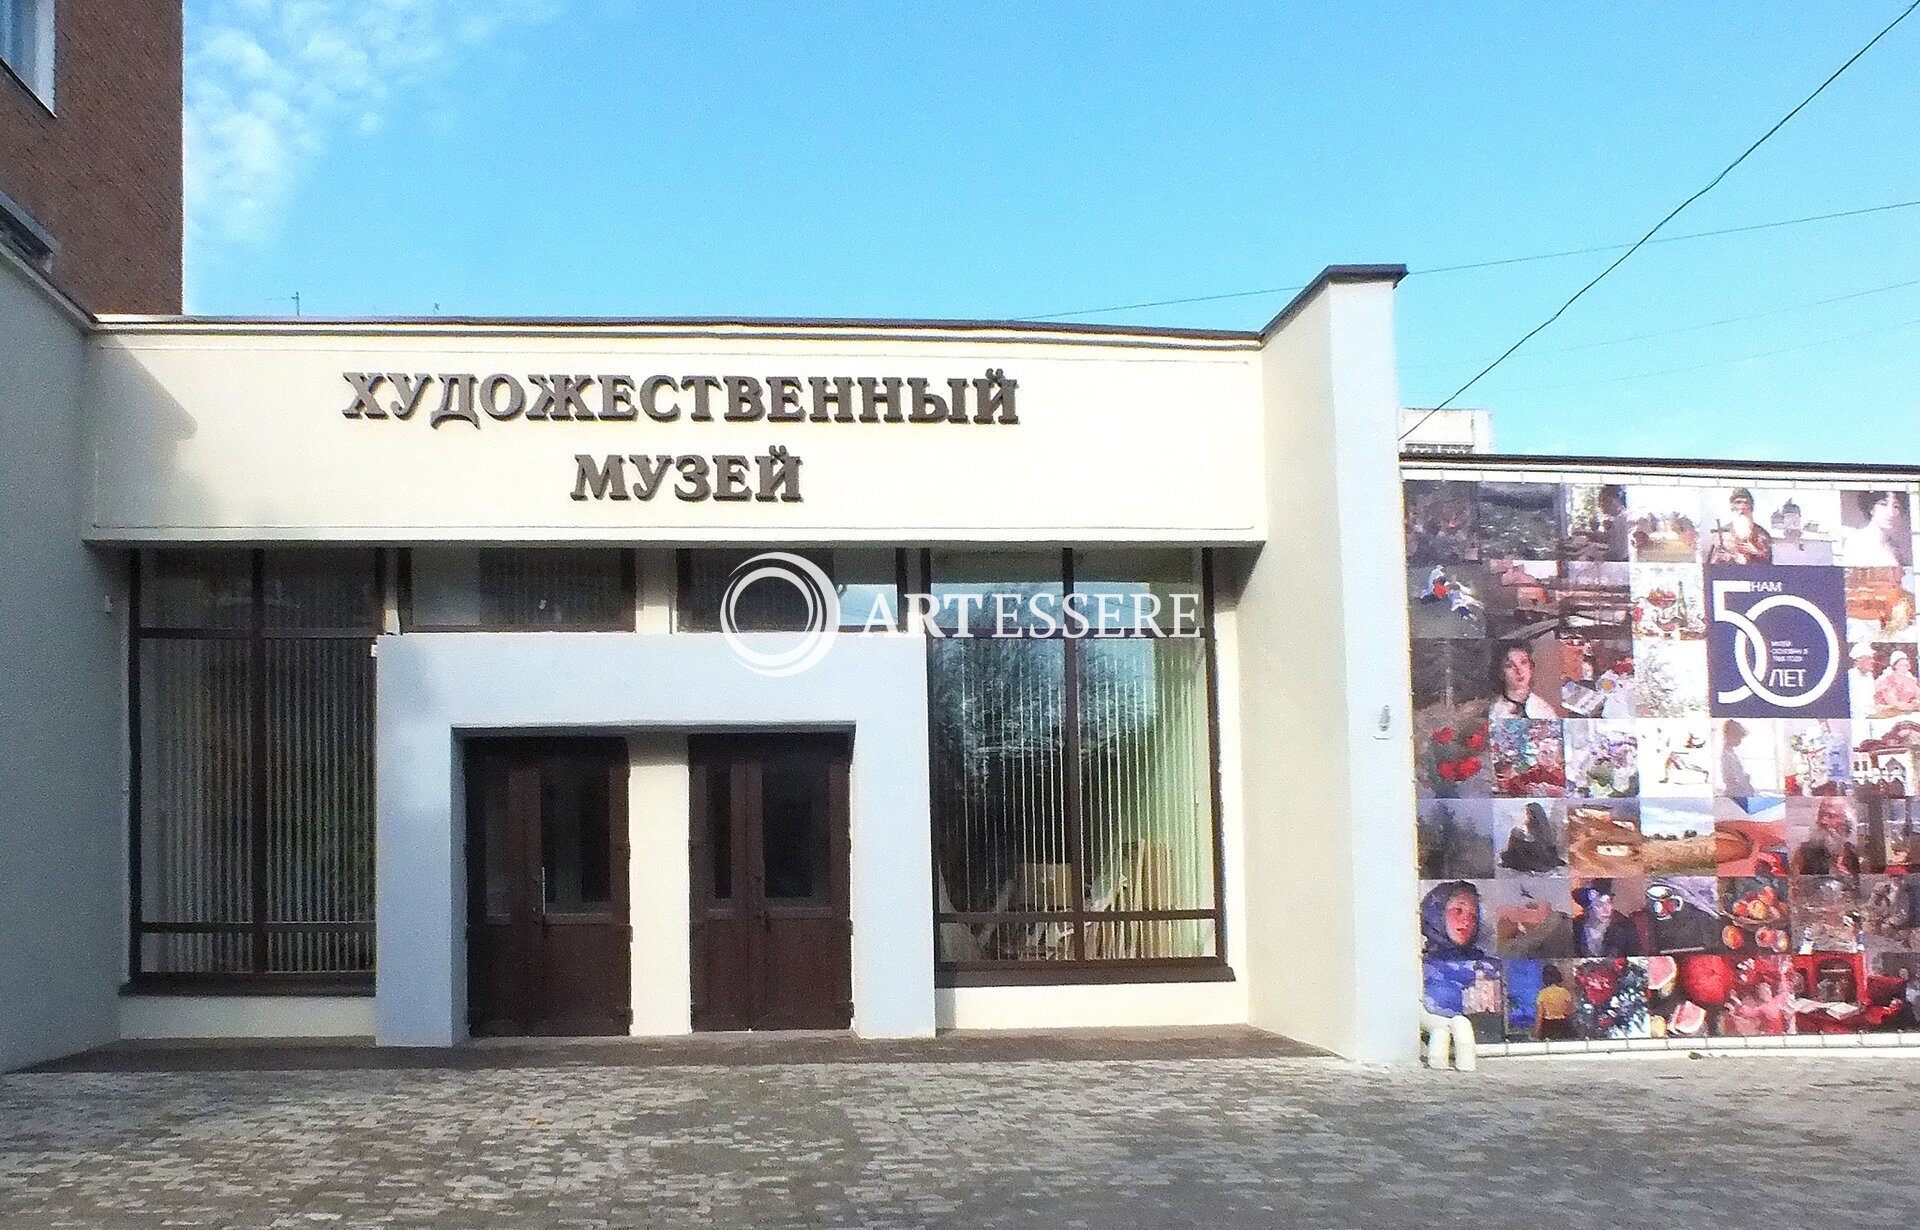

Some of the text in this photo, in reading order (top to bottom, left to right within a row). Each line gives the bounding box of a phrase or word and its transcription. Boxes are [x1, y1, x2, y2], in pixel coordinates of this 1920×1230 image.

[342, 368, 1020, 430] ХУДОЖЕСТВЕННЫЙ
[570, 445, 804, 503] МУЗЕЙ
[1751, 581, 1783, 592] НАМ
[1712, 580, 1840, 708] 50
[1768, 668, 1807, 688] ЛЕТ
